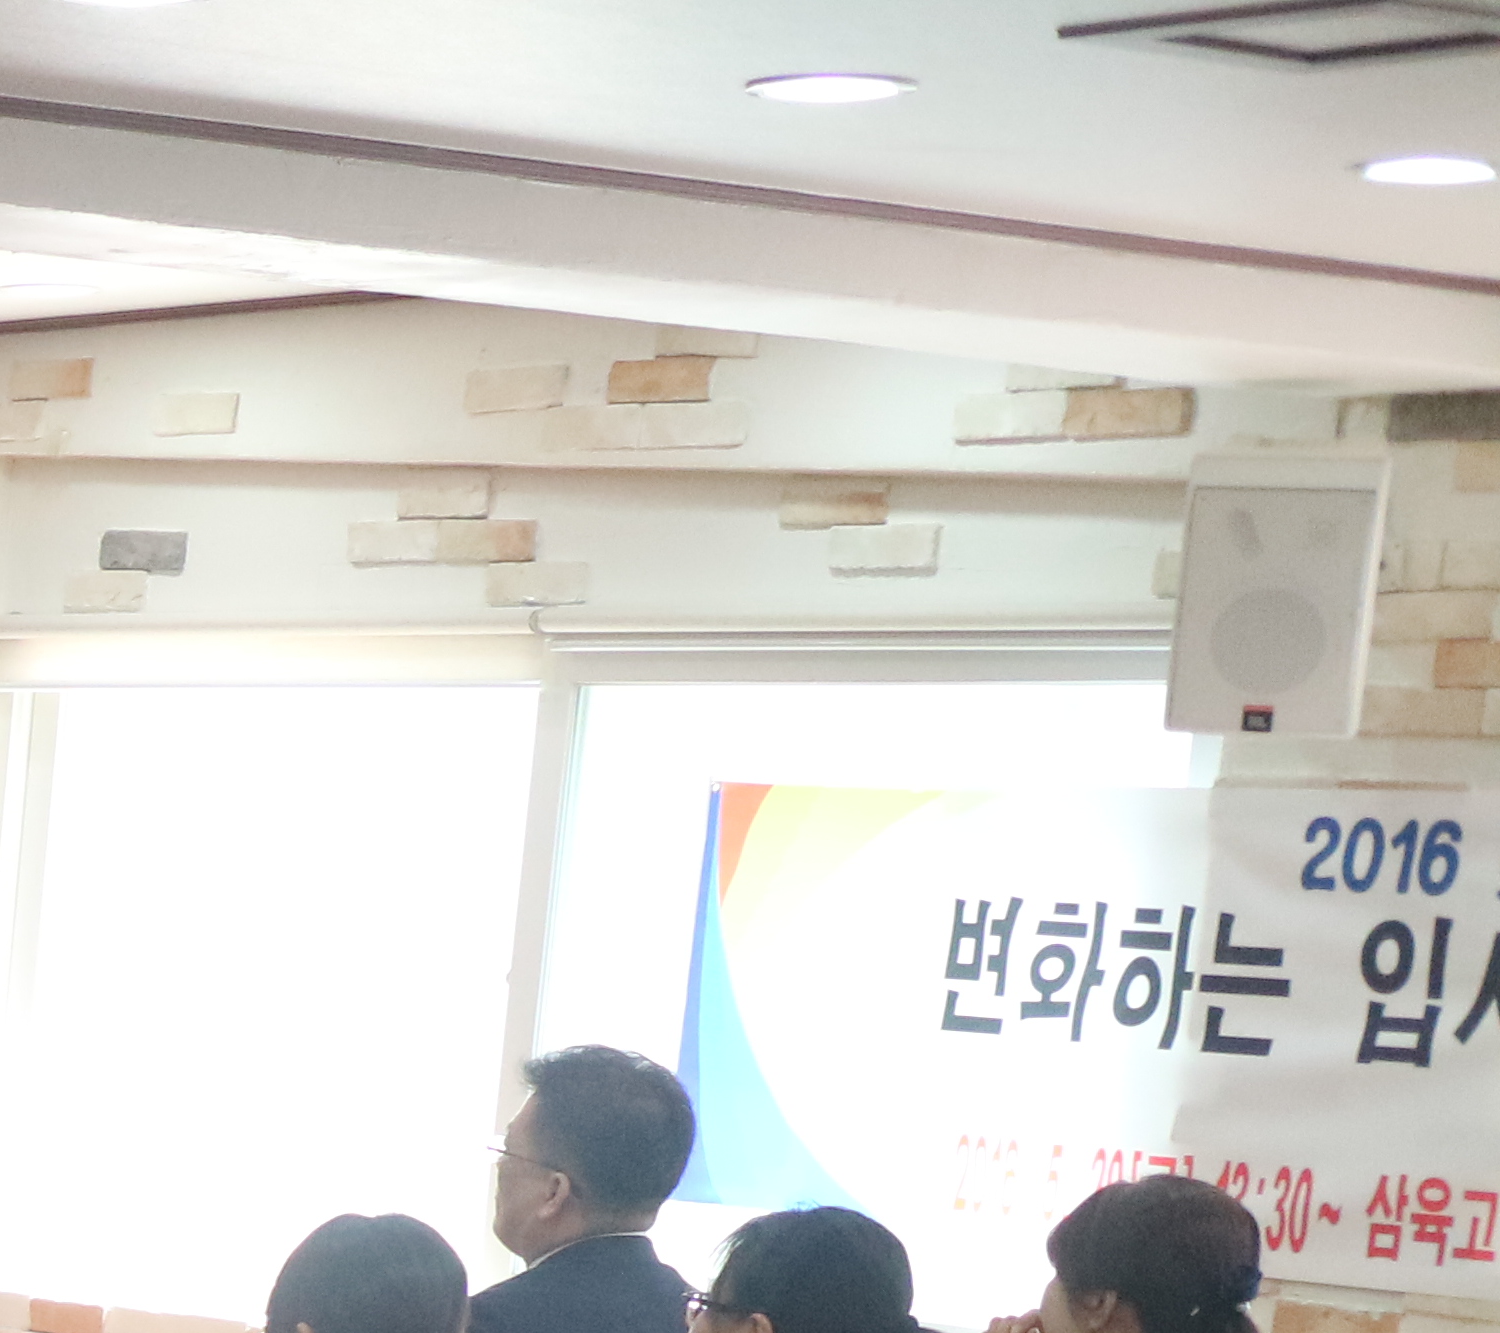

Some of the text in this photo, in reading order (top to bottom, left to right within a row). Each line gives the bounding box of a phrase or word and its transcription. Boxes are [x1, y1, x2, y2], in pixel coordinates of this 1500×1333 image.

[1300, 816, 1462, 896] 2016
[941, 896, 1292, 1056] 변화하는
[1366, 1174, 1499, 1266] 삼육고
